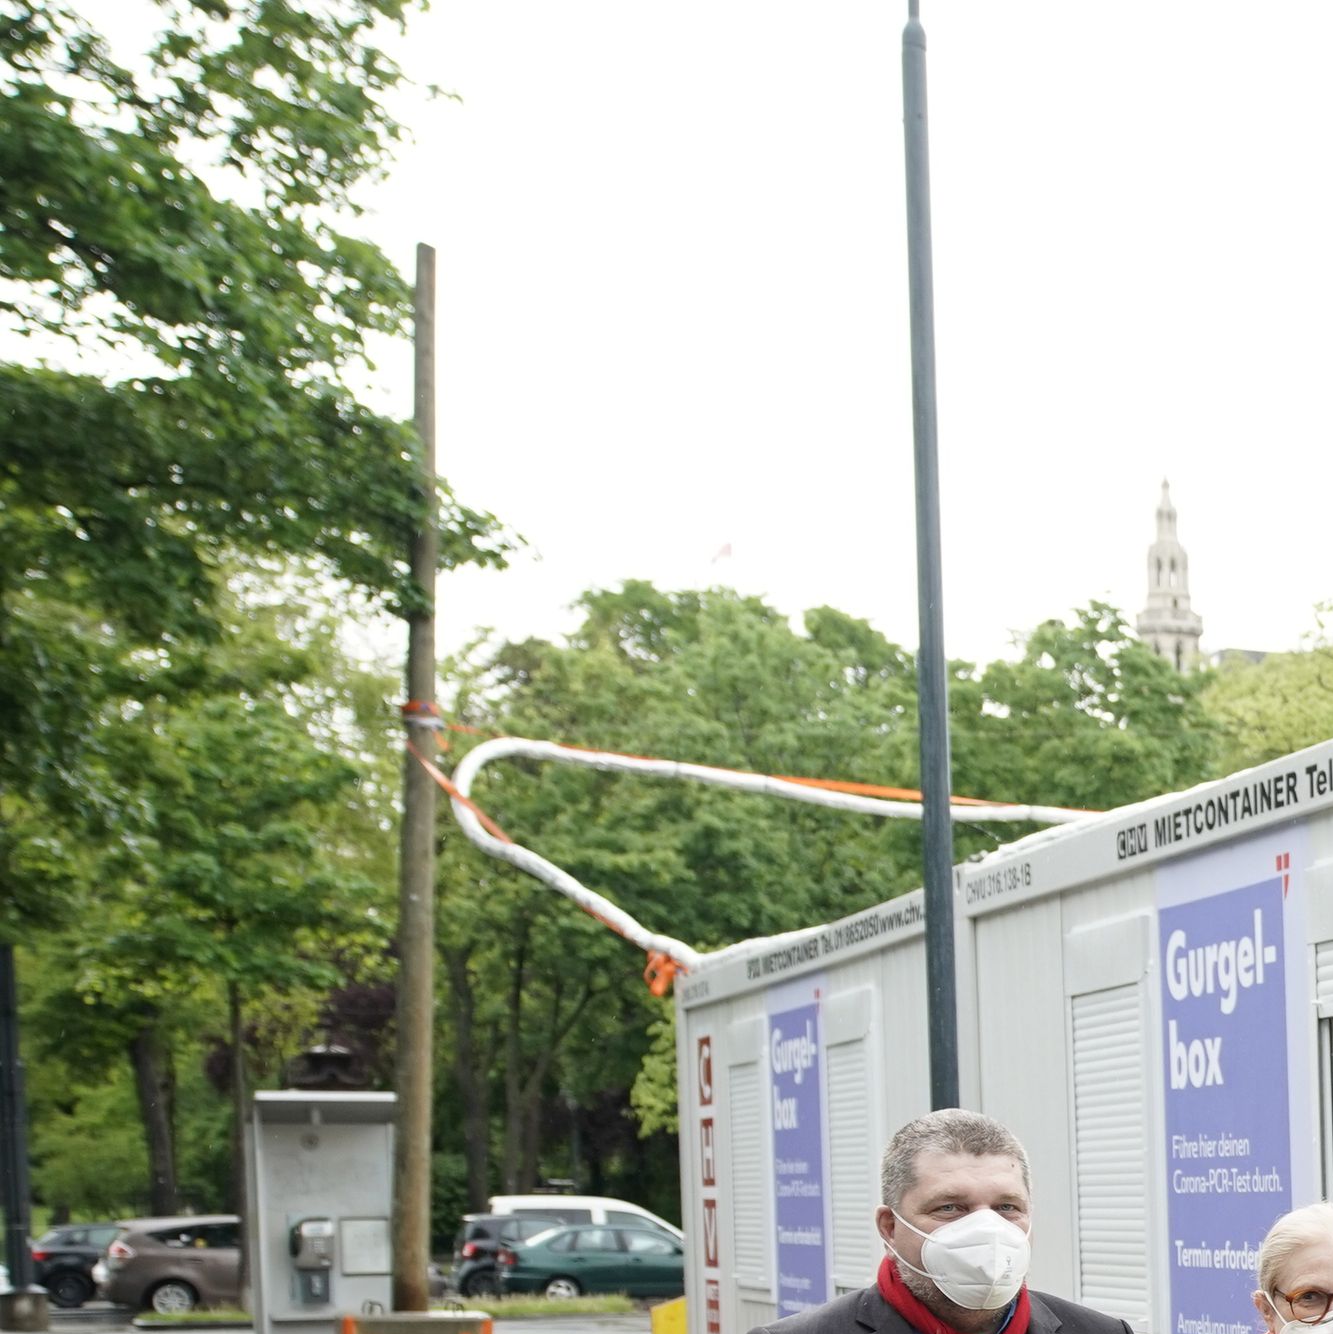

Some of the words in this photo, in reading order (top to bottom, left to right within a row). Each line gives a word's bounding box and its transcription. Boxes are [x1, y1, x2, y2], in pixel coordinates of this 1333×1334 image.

[1154, 771, 1299, 849] MIETCONTAINER
[1166, 908, 1277, 1015] Gurgel-
[1168, 1019, 1224, 1090] box
[773, 1085, 798, 1130] box
[1172, 1135, 1199, 1159] Führe
[1199, 1133, 1217, 1158] hier
[1218, 1132, 1250, 1157] deinen
[1173, 1167, 1251, 1194] Corona-PCR-Test
[1252, 1166, 1283, 1192] durch.
[1175, 1240, 1212, 1267] Termin
